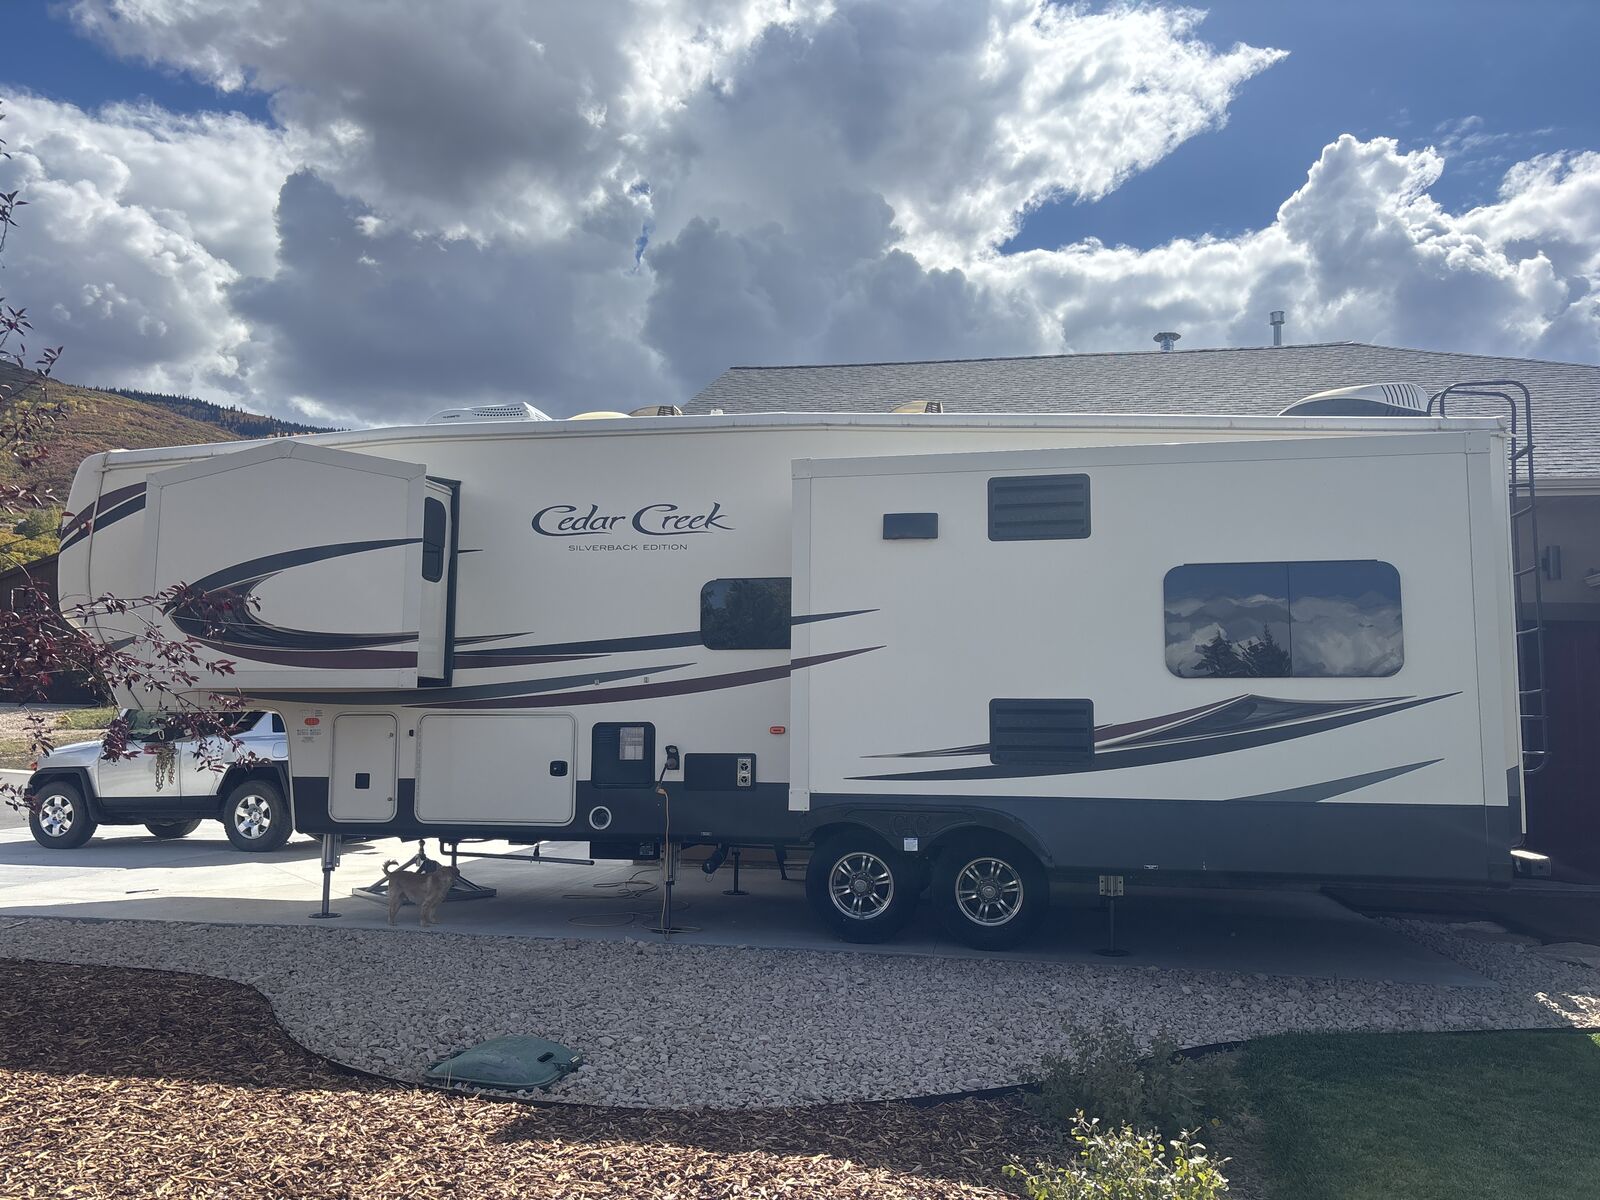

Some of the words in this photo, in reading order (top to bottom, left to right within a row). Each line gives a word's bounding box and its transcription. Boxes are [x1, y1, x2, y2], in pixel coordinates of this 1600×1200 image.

[531, 504, 626, 537] Cedar
[631, 501, 736, 536] Creek
[568, 543, 639, 552] SILVERBACK
[642, 543, 688, 551] EDITION
